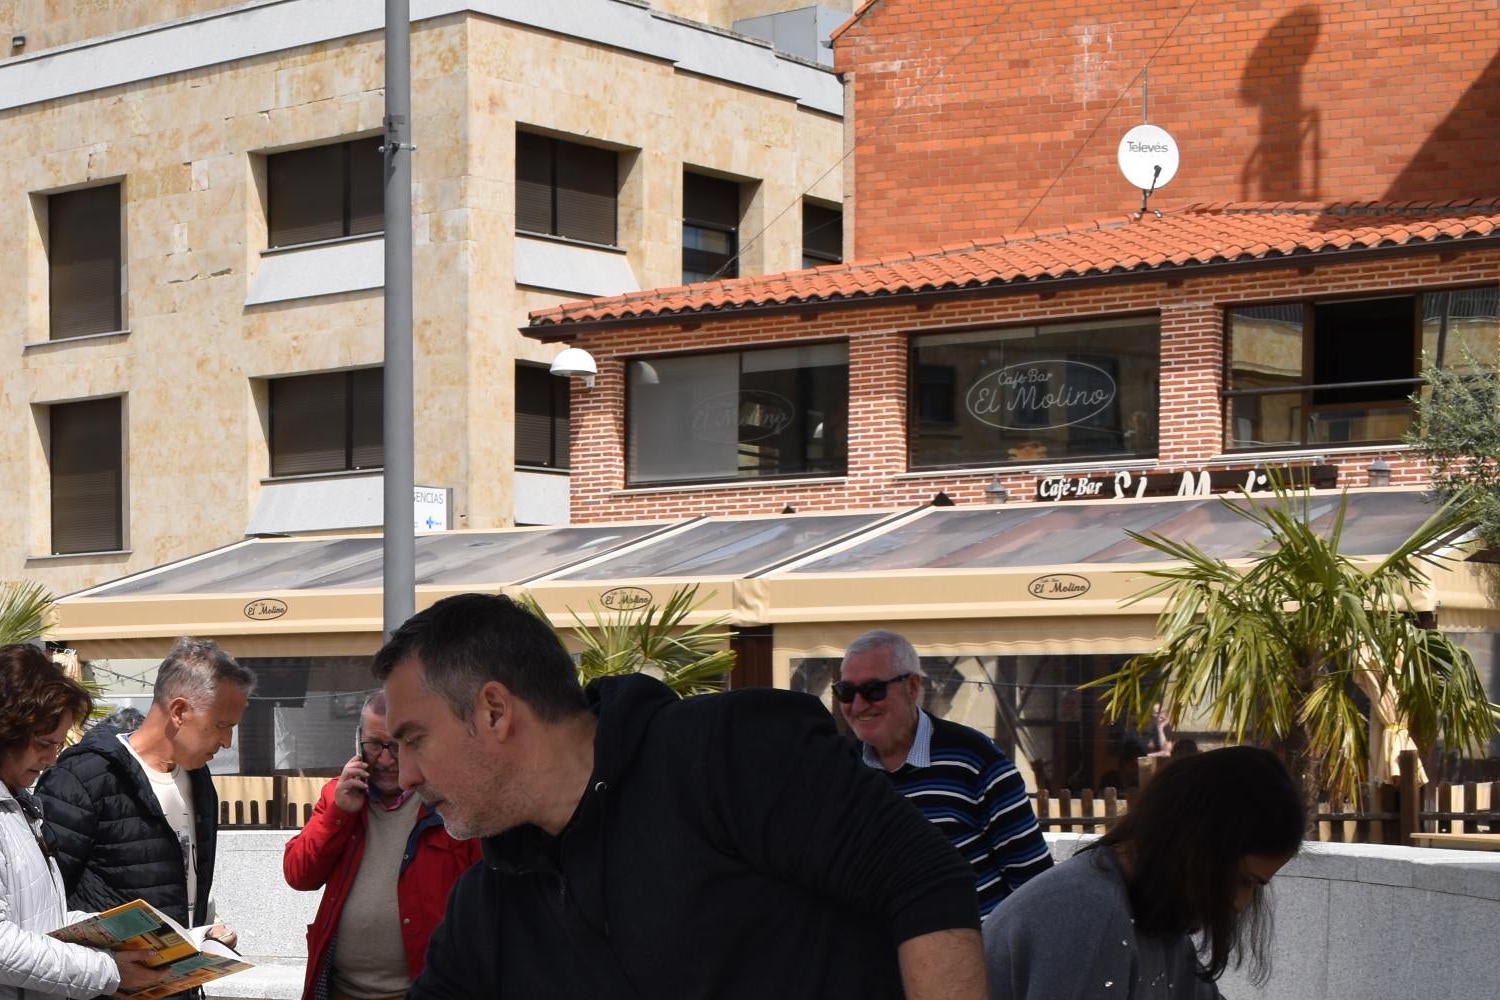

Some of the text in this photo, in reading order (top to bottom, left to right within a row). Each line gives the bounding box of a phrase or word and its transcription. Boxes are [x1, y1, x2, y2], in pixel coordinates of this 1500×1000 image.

[1127, 141, 1168, 153] Televés
[974, 384, 1108, 414] El Molino
[413, 491, 444, 505] ENCIAS
[1034, 582, 1086, 594] El Molino
